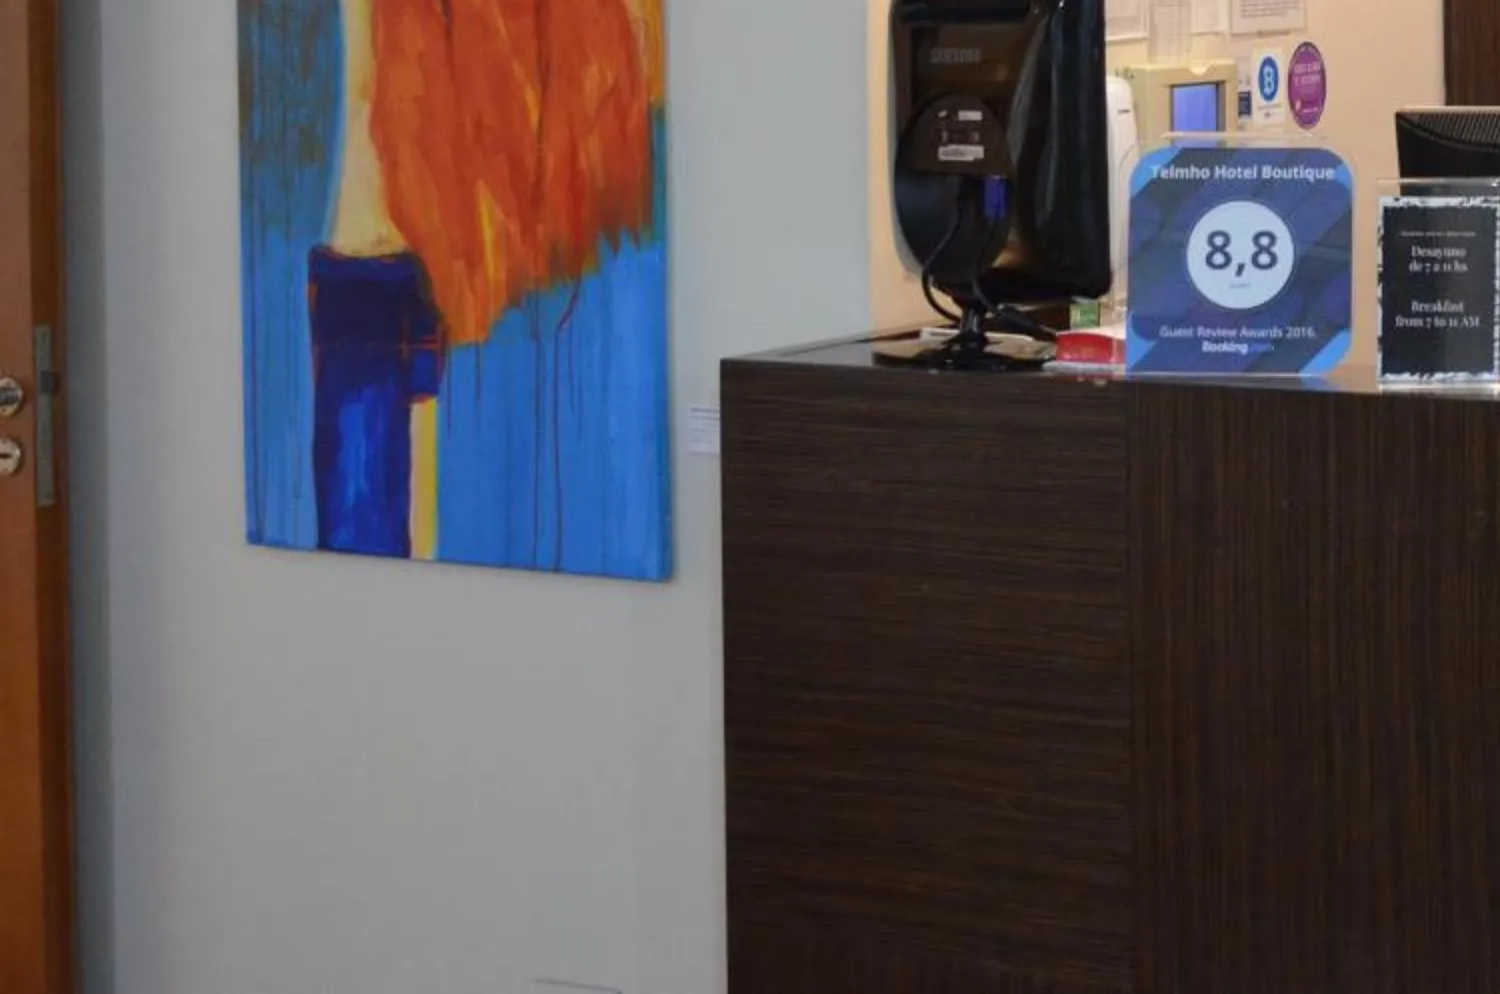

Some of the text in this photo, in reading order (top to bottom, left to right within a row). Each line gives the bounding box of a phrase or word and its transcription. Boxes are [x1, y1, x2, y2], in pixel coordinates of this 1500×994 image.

[1152, 165, 1335, 182] Telmho Hotel Boutique
[1205, 230, 1278, 277] 8,8
[1411, 245, 1467, 259] Desayuno
[1409, 260, 1421, 272] de
[1411, 300, 1464, 313] Breakfast
[1395, 315, 1423, 327] from
[1434, 316, 1446, 327] to
[1462, 316, 1479, 327] AM
[1160, 326, 1193, 338] Guest
[1197, 326, 1237, 338] Review
[1240, 326, 1283, 338] Awards
